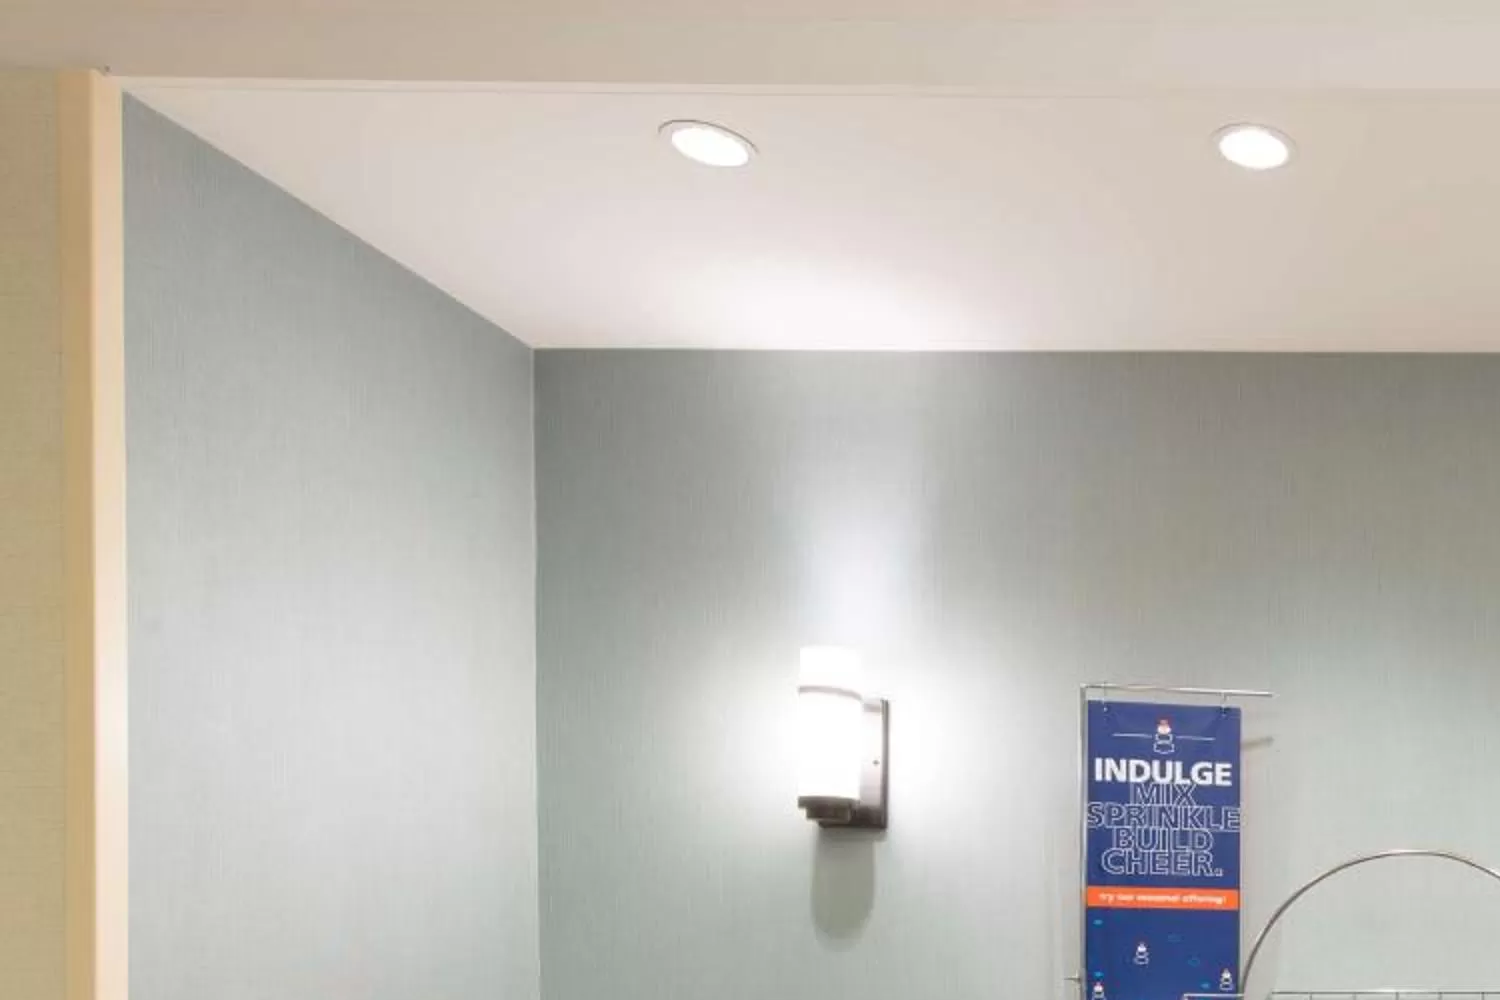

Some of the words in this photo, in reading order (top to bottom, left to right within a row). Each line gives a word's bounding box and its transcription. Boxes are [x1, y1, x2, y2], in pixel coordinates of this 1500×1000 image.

[1094, 757, 1232, 786] INDULGE
[1130, 782, 1197, 807] MIX
[1087, 801, 1240, 832] SPRINKLE
[1113, 827, 1214, 853] BUILD
[1101, 848, 1223, 877] CHEER.
